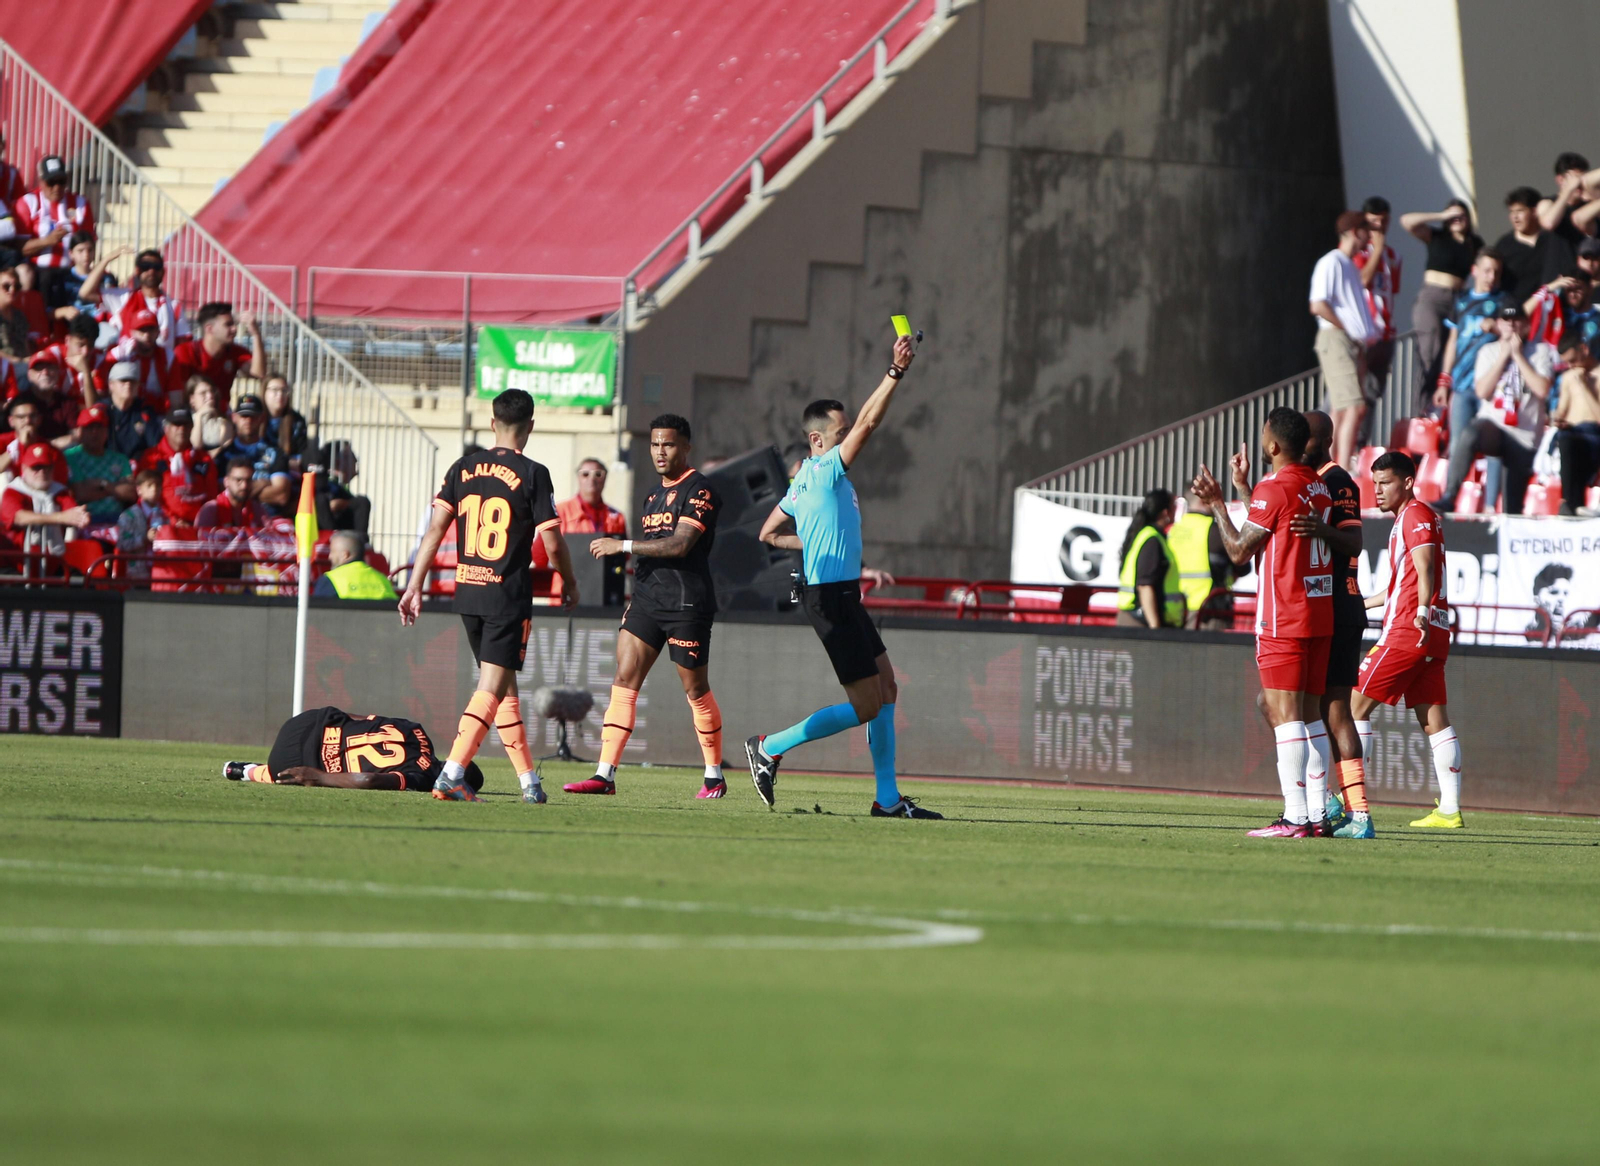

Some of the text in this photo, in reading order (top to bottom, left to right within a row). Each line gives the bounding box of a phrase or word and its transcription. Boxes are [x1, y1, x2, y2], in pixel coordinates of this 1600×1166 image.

[461, 462, 521, 491] A. ALMEIDA
[457, 493, 512, 561] 18
[1035, 646, 1134, 708] POWER
[345, 724, 405, 773] 12
[1034, 710, 1134, 774] HORSE
